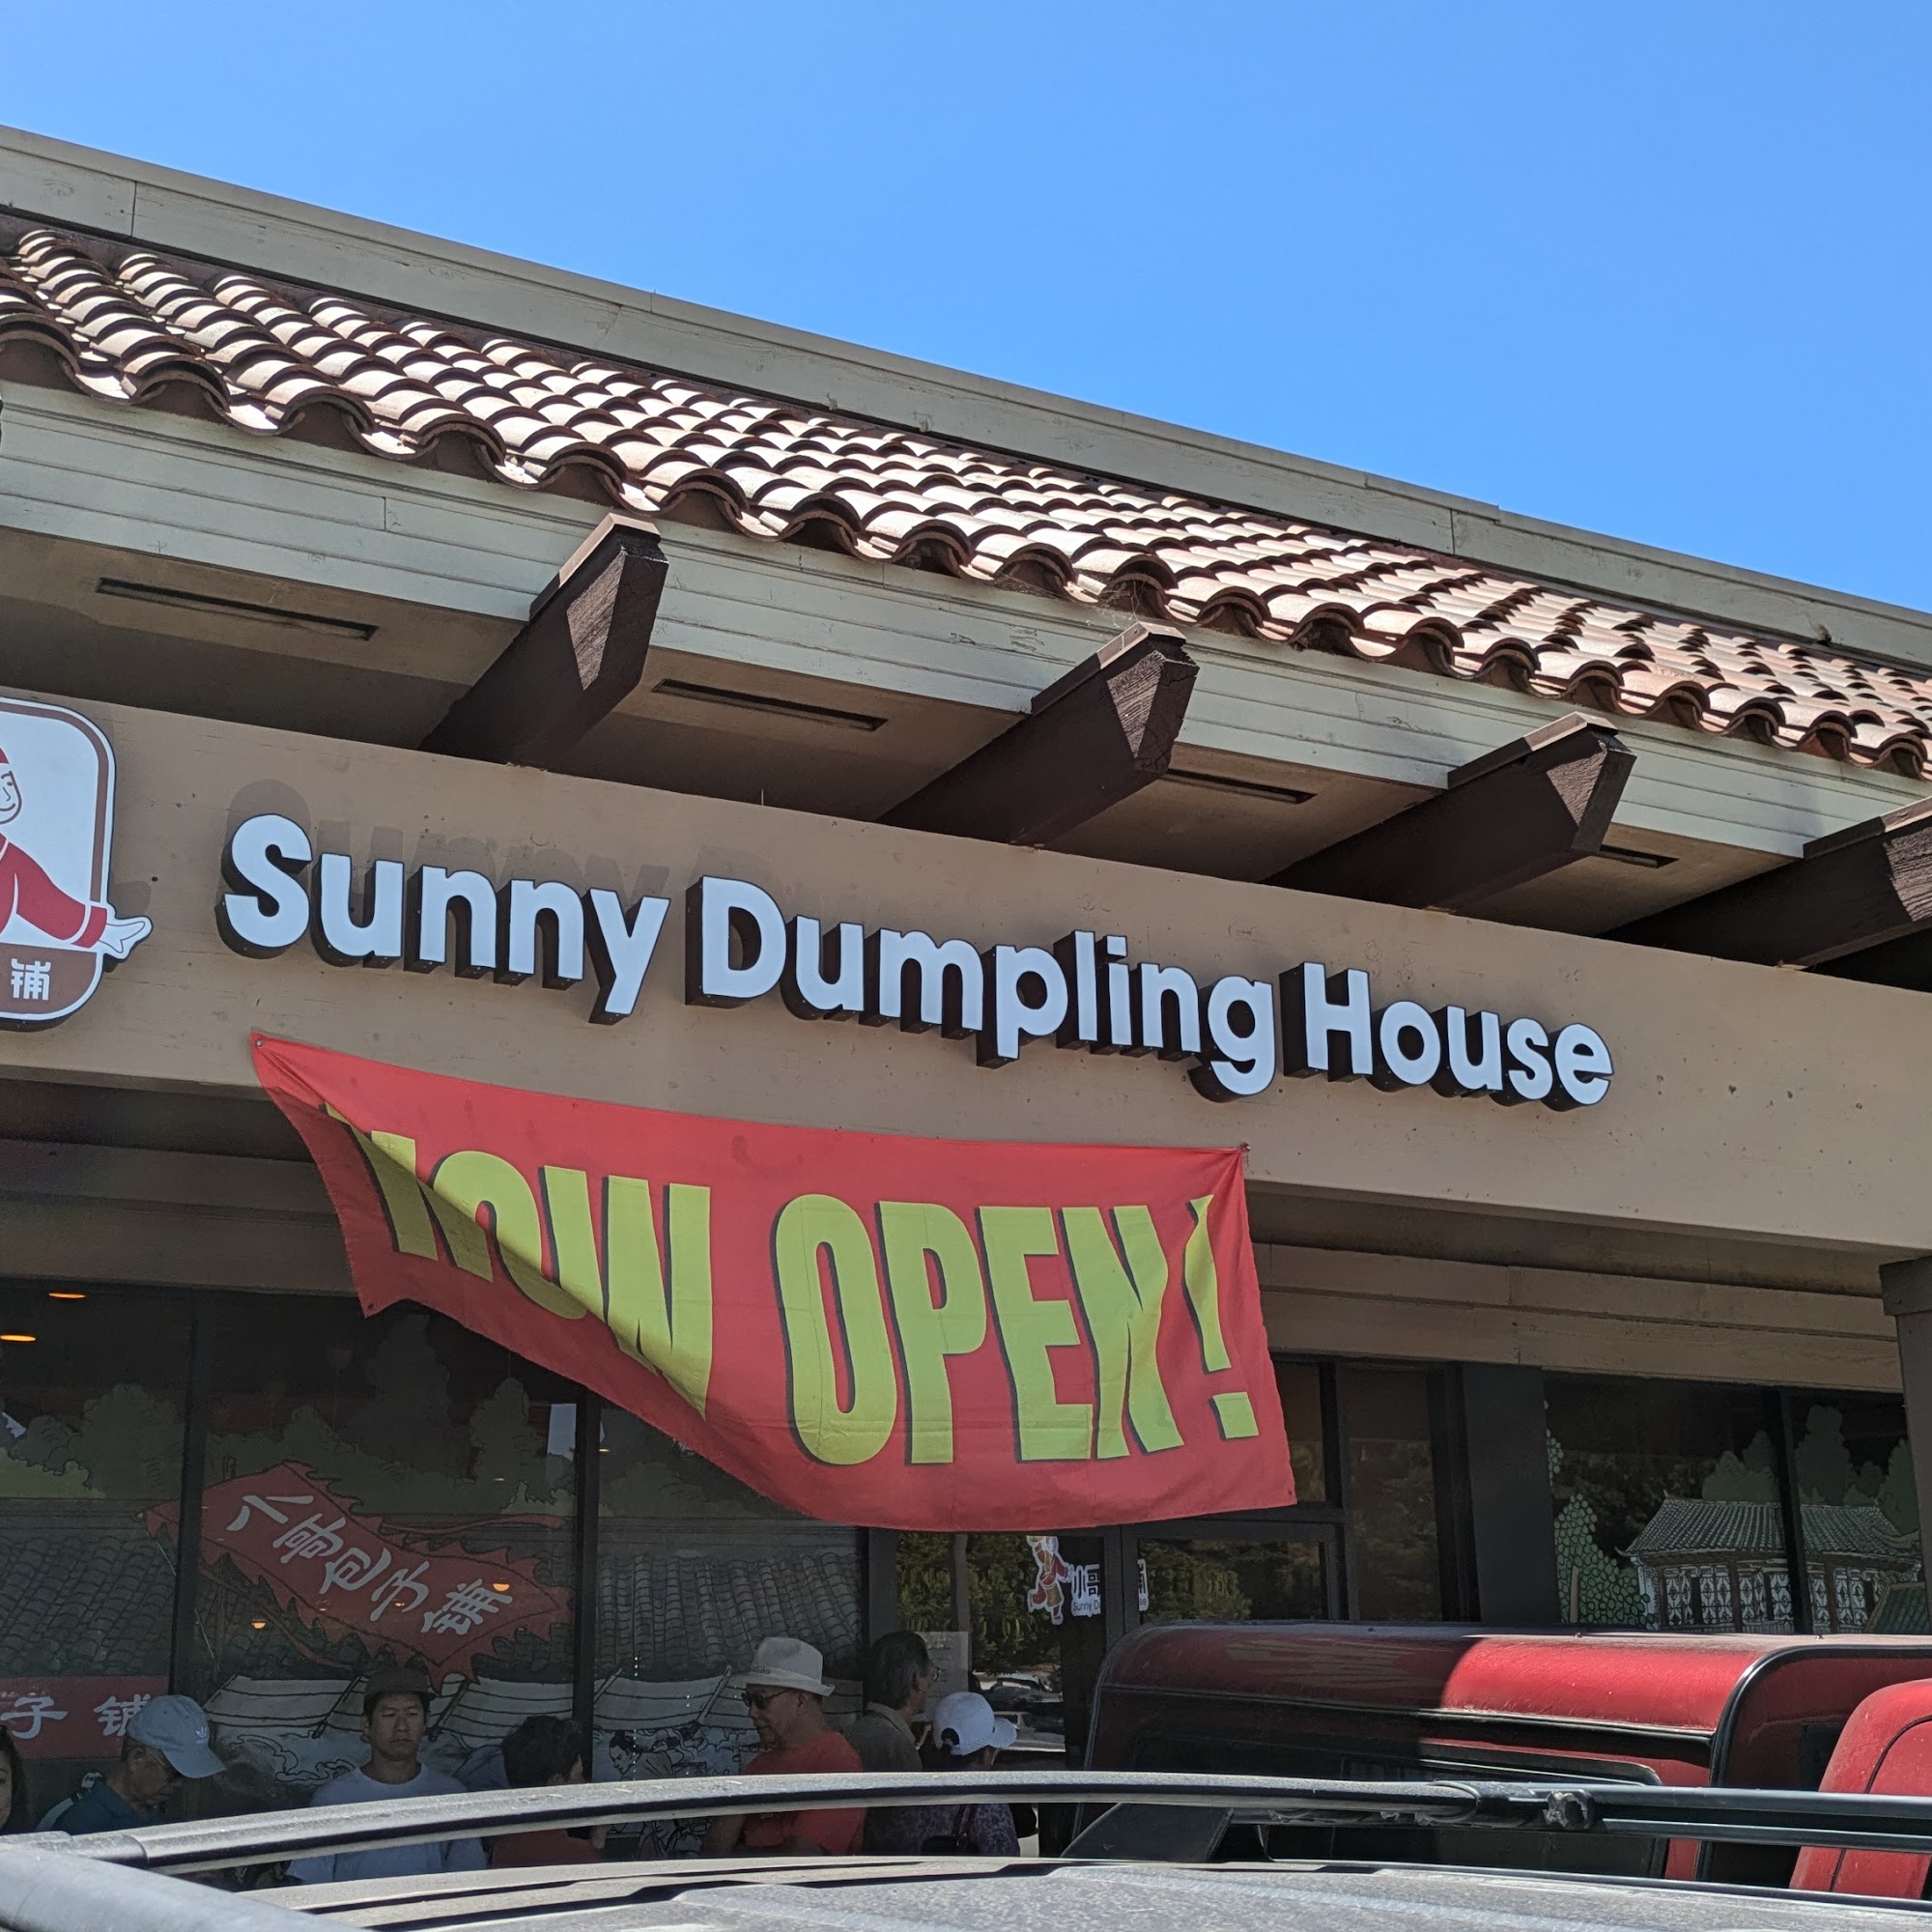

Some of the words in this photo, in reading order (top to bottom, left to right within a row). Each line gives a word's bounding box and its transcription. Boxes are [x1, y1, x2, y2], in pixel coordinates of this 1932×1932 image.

[222, 813, 671, 1017] Sunny
[697, 875, 1274, 1096] Dumpling
[1300, 962, 1613, 1107] House
[1072, 1602, 1094, 1612] Sunny
